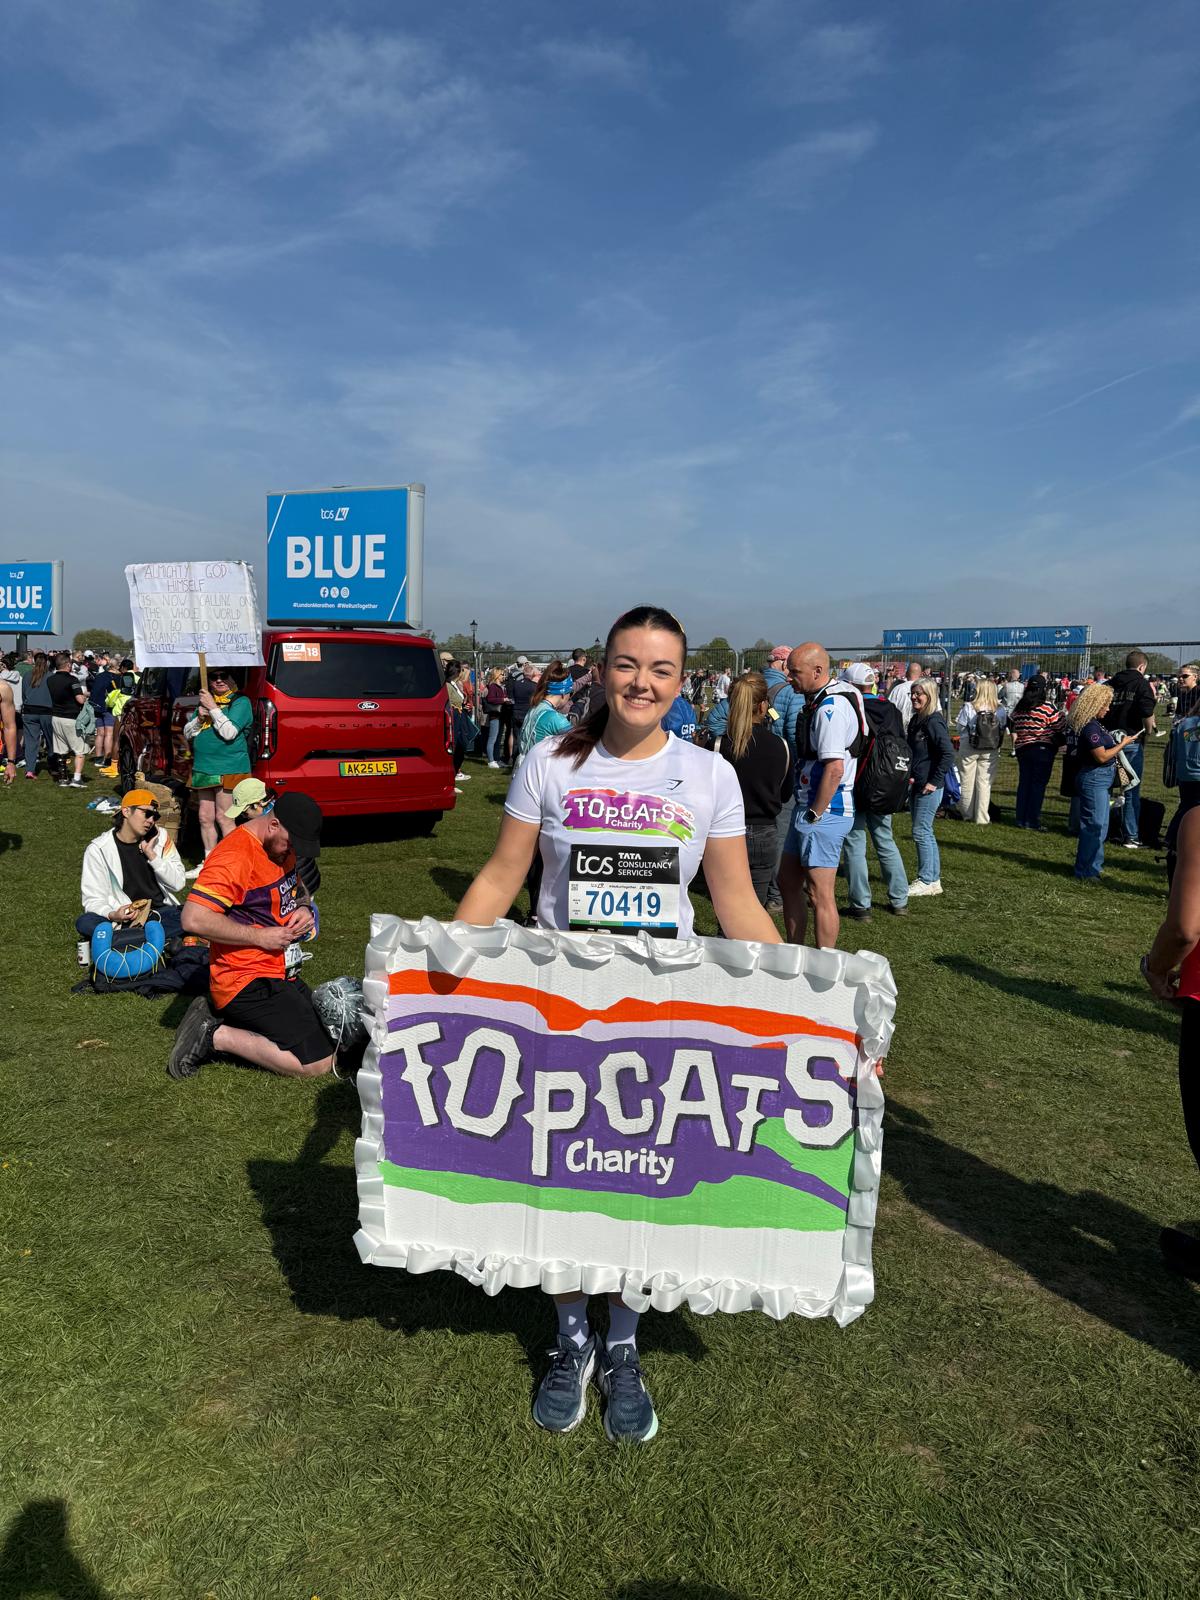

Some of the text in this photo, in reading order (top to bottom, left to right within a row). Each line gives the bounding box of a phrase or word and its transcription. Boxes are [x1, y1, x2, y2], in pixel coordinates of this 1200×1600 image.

[321, 508, 335, 519] tcs
[287, 534, 386, 579] BLUE
[205, 564, 228, 579] GOD
[167, 579, 205, 592] HIMSELF
[141, 595, 152, 606] IS
[162, 595, 187, 606] NOW
[144, 607, 240, 619] THE WHOLE WORLD
[147, 620, 159, 631] TO
[193, 621, 210, 632] TO
[149, 632, 248, 644] AGAINST THE ZIONIST
[150, 644, 175, 652] ENTITY
[191, 644, 207, 652] SAYS
[215, 644, 228, 652] THE
[306, 648, 319, 656] 18
[347, 762, 395, 774] AK25 LSF
[611, 819, 643, 830] Charity
[618, 852, 641, 860] TATA
[577, 851, 614, 875] tcs
[618, 861, 673, 869] CONSULTANCY
[585, 890, 661, 918] 70419
[381, 1022, 856, 1177] TOPCATS
[566, 1139, 675, 1185] Charity
